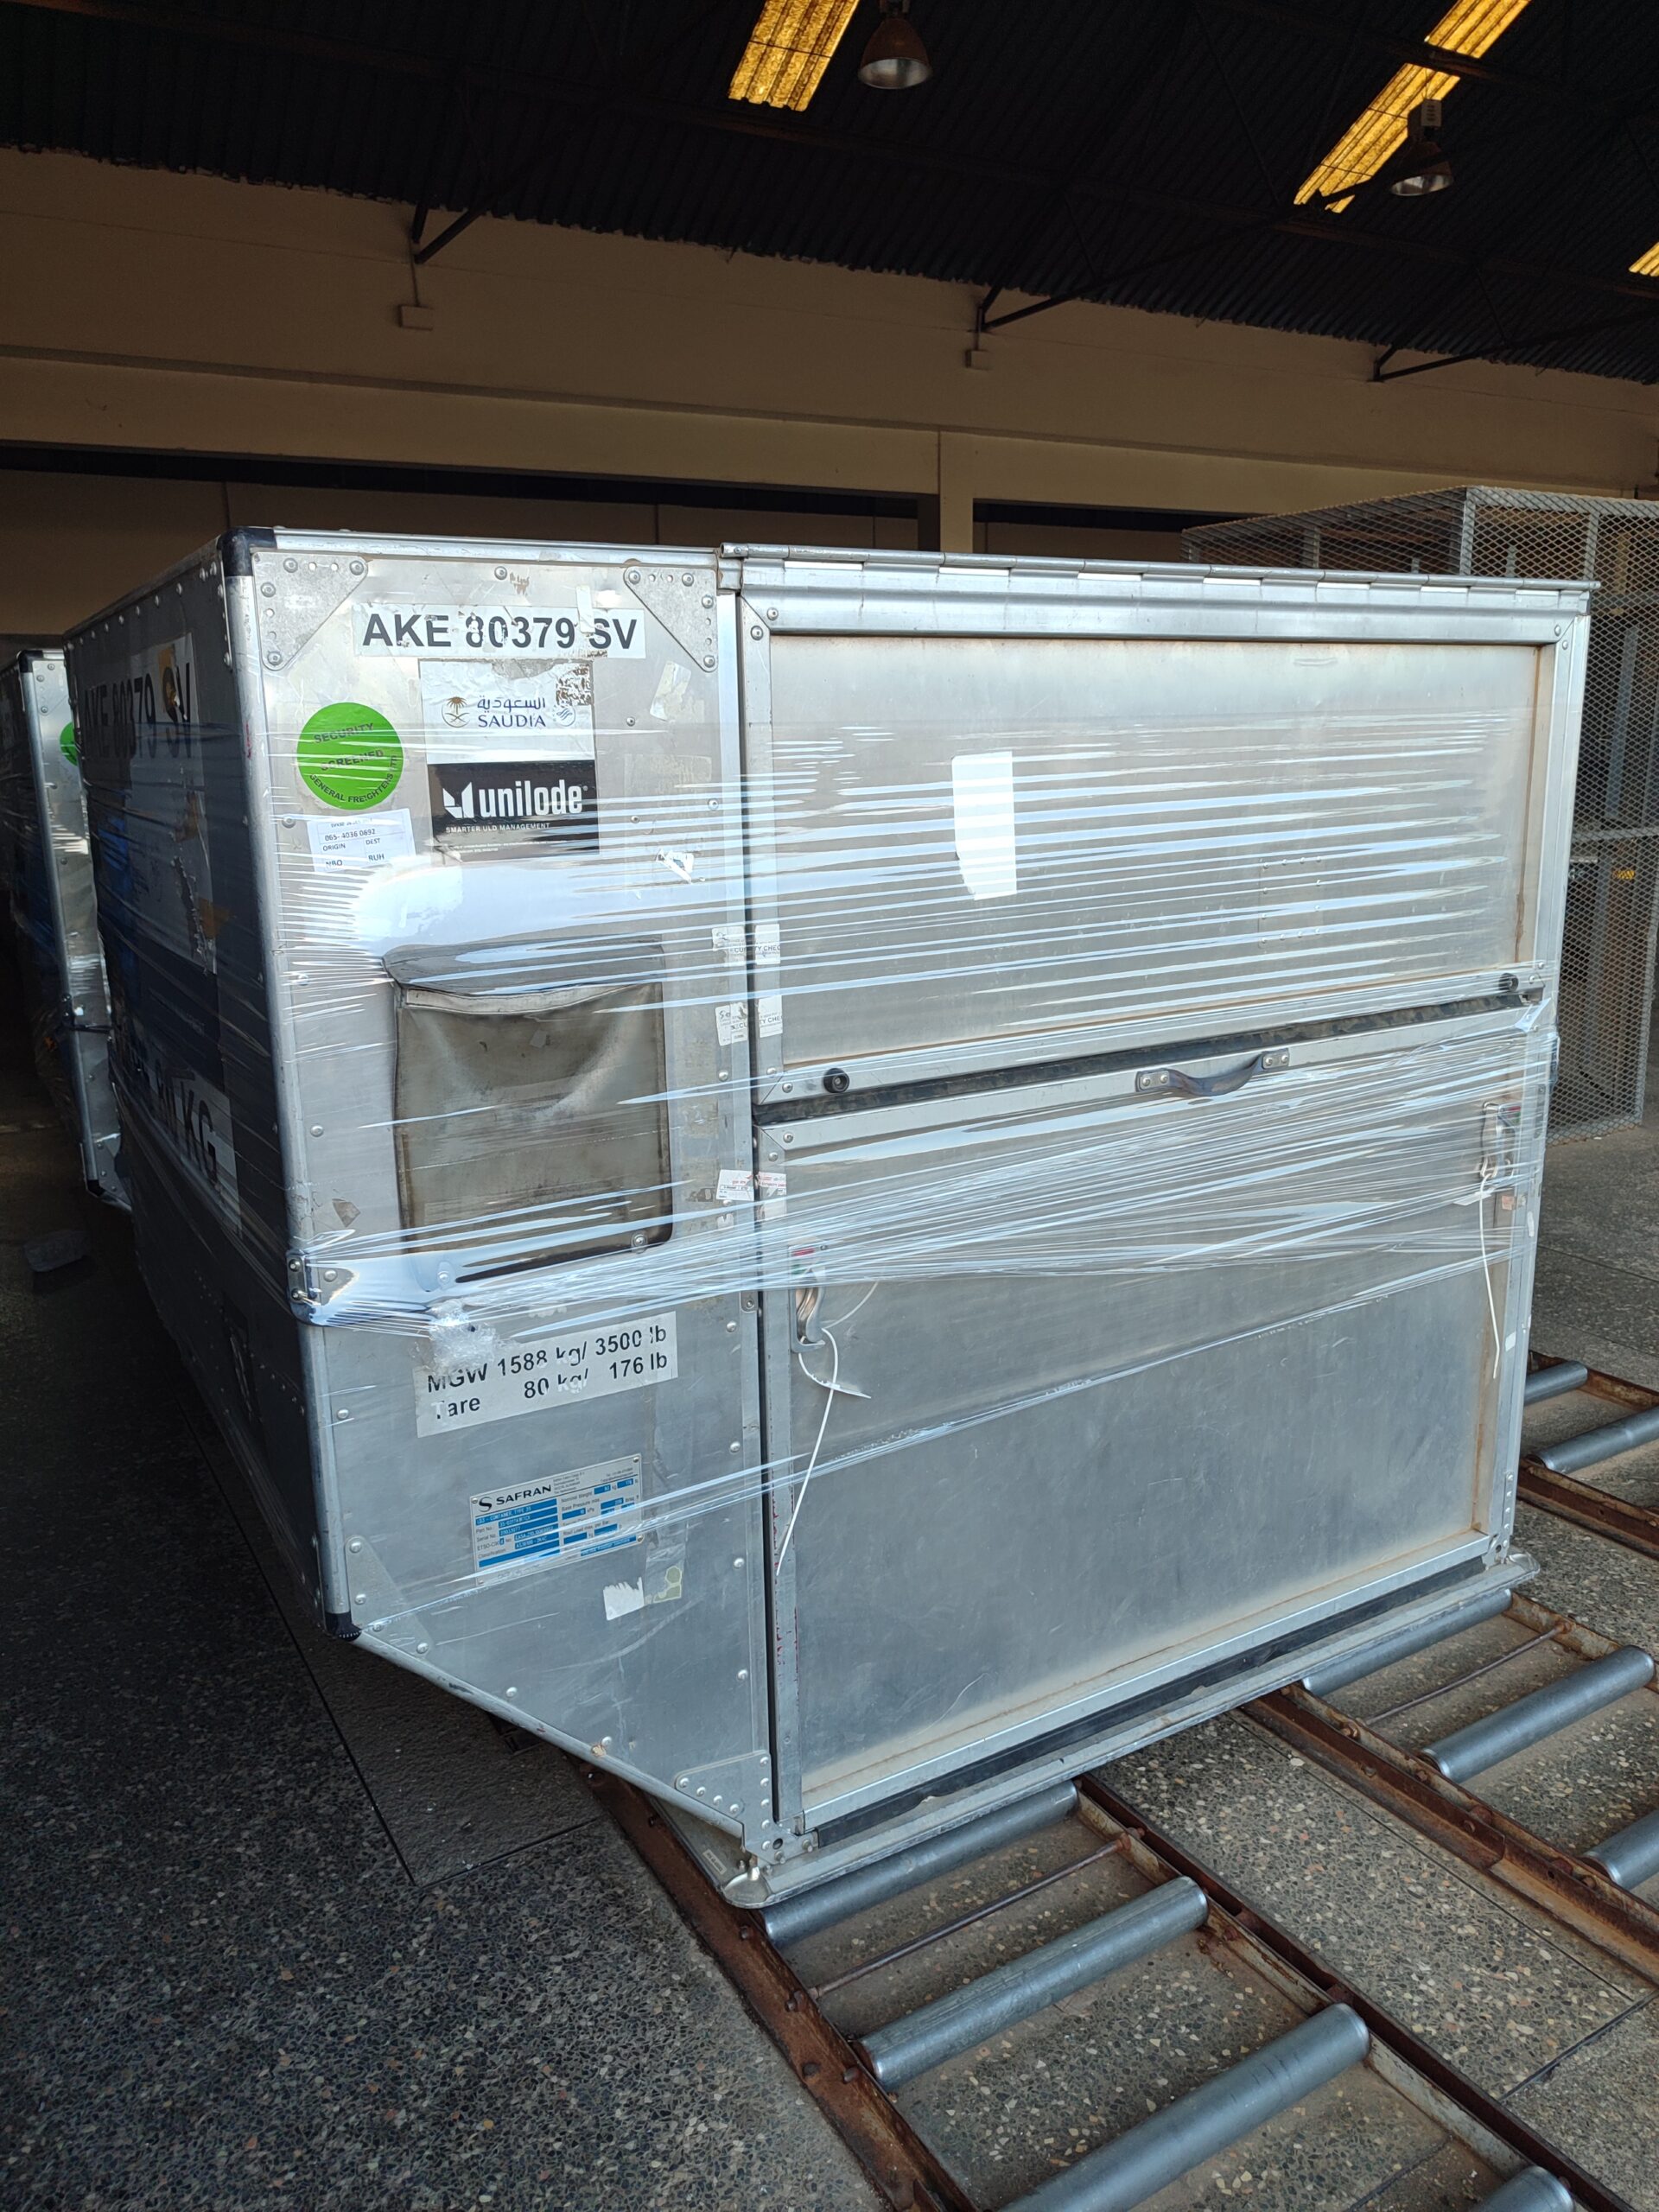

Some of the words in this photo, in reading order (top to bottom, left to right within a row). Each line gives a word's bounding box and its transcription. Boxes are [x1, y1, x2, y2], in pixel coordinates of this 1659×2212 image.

[362, 613, 452, 648] AKE
[464, 614, 575, 649] 80379
[588, 617, 638, 650] SV
[476, 695, 546, 714] السعودية
[477, 714, 547, 728] SAUDIA
[313, 722, 374, 744] SECURITY
[320, 748, 385, 772] SCREENED
[309, 774, 346, 801] GENERAL
[478, 779, 582, 818] unilode
[341, 830, 359, 839] 4036
[445, 825, 481, 834] SMARTER
[499, 822, 551, 831] MANAGEMENT
[322, 842, 346, 852] ORIGIN
[368, 853, 385, 861] RUH
[497, 1349, 549, 1377] 1588
[594, 1329, 643, 1357] 3500
[649, 1325, 668, 1344] lb
[523, 1376, 550, 1400] 80
[608, 1356, 644, 1381] 176
[650, 1351, 668, 1371] lb
[496, 1484, 552, 1505] SAFRAN
